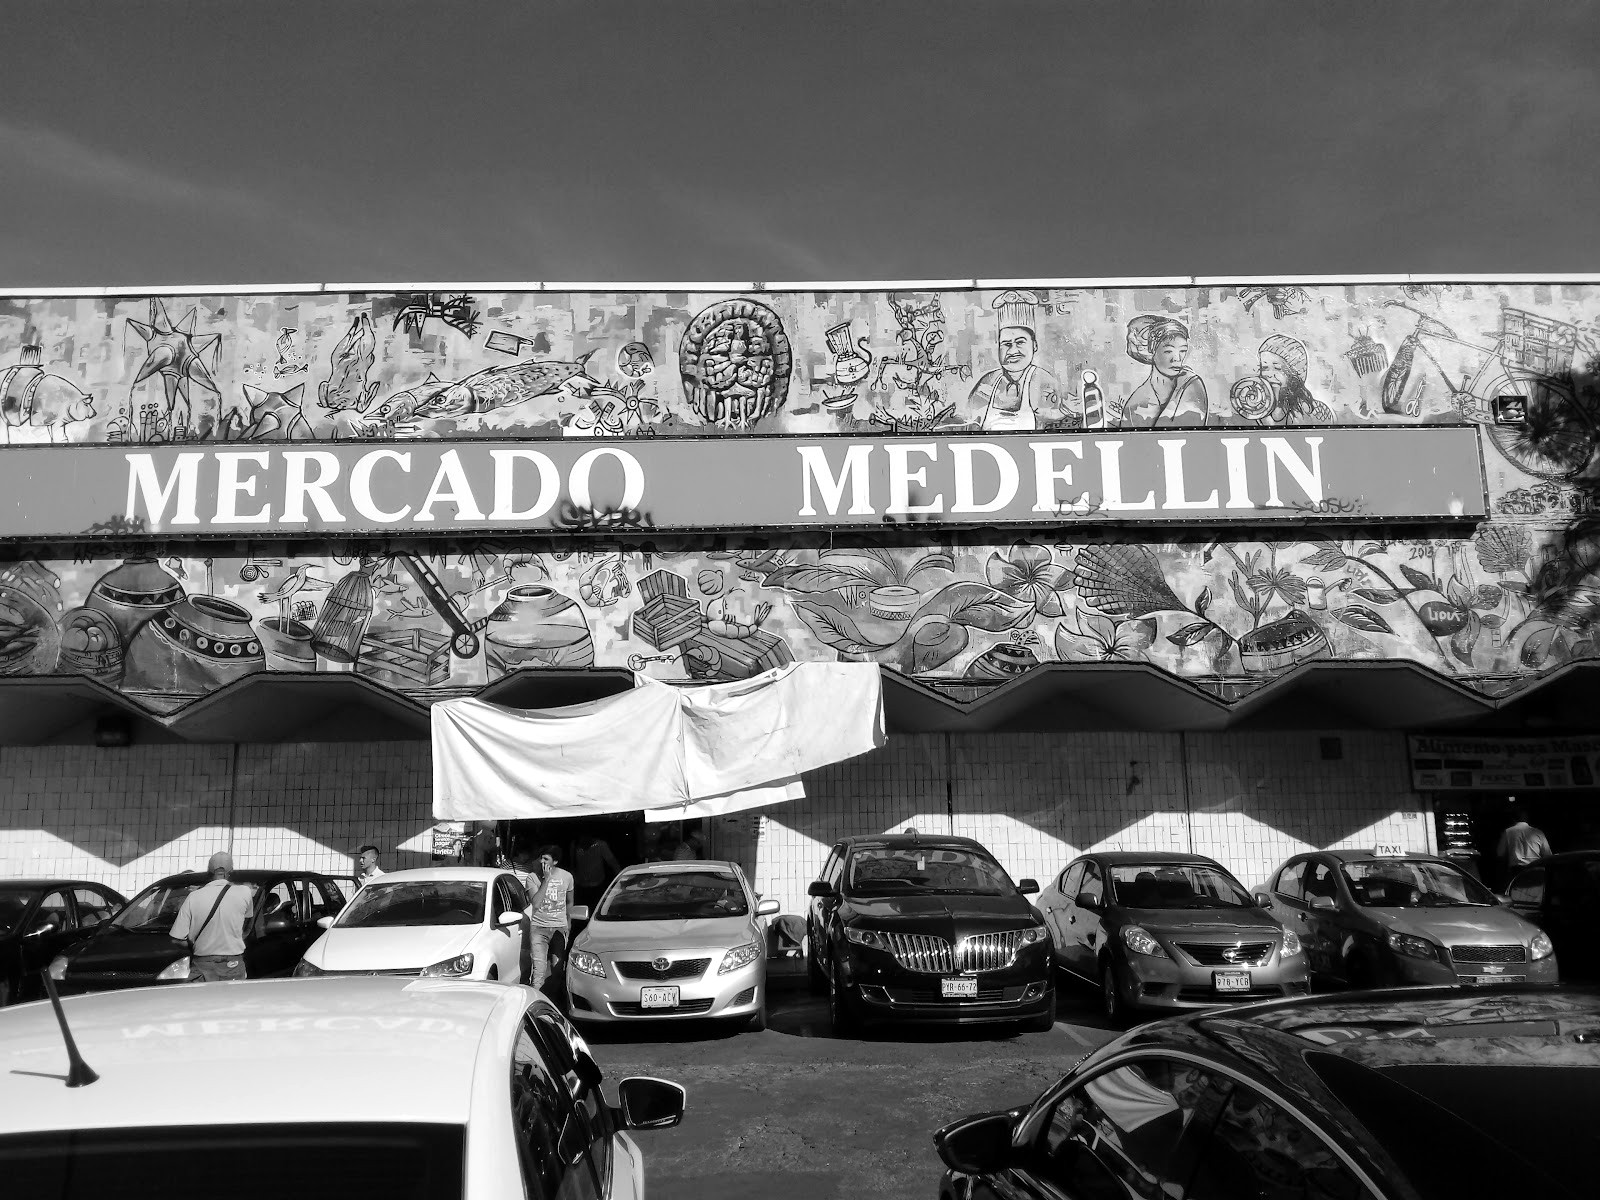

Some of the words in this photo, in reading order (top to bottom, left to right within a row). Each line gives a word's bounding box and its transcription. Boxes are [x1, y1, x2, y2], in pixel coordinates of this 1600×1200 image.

[125, 447, 646, 525] MERCADO
[796, 436, 1325, 516] MEDELLIN
[1408, 545, 1435, 561] 2013
[1378, 845, 1402, 854] TAXI
[942, 982, 977, 992] PYR-66-72
